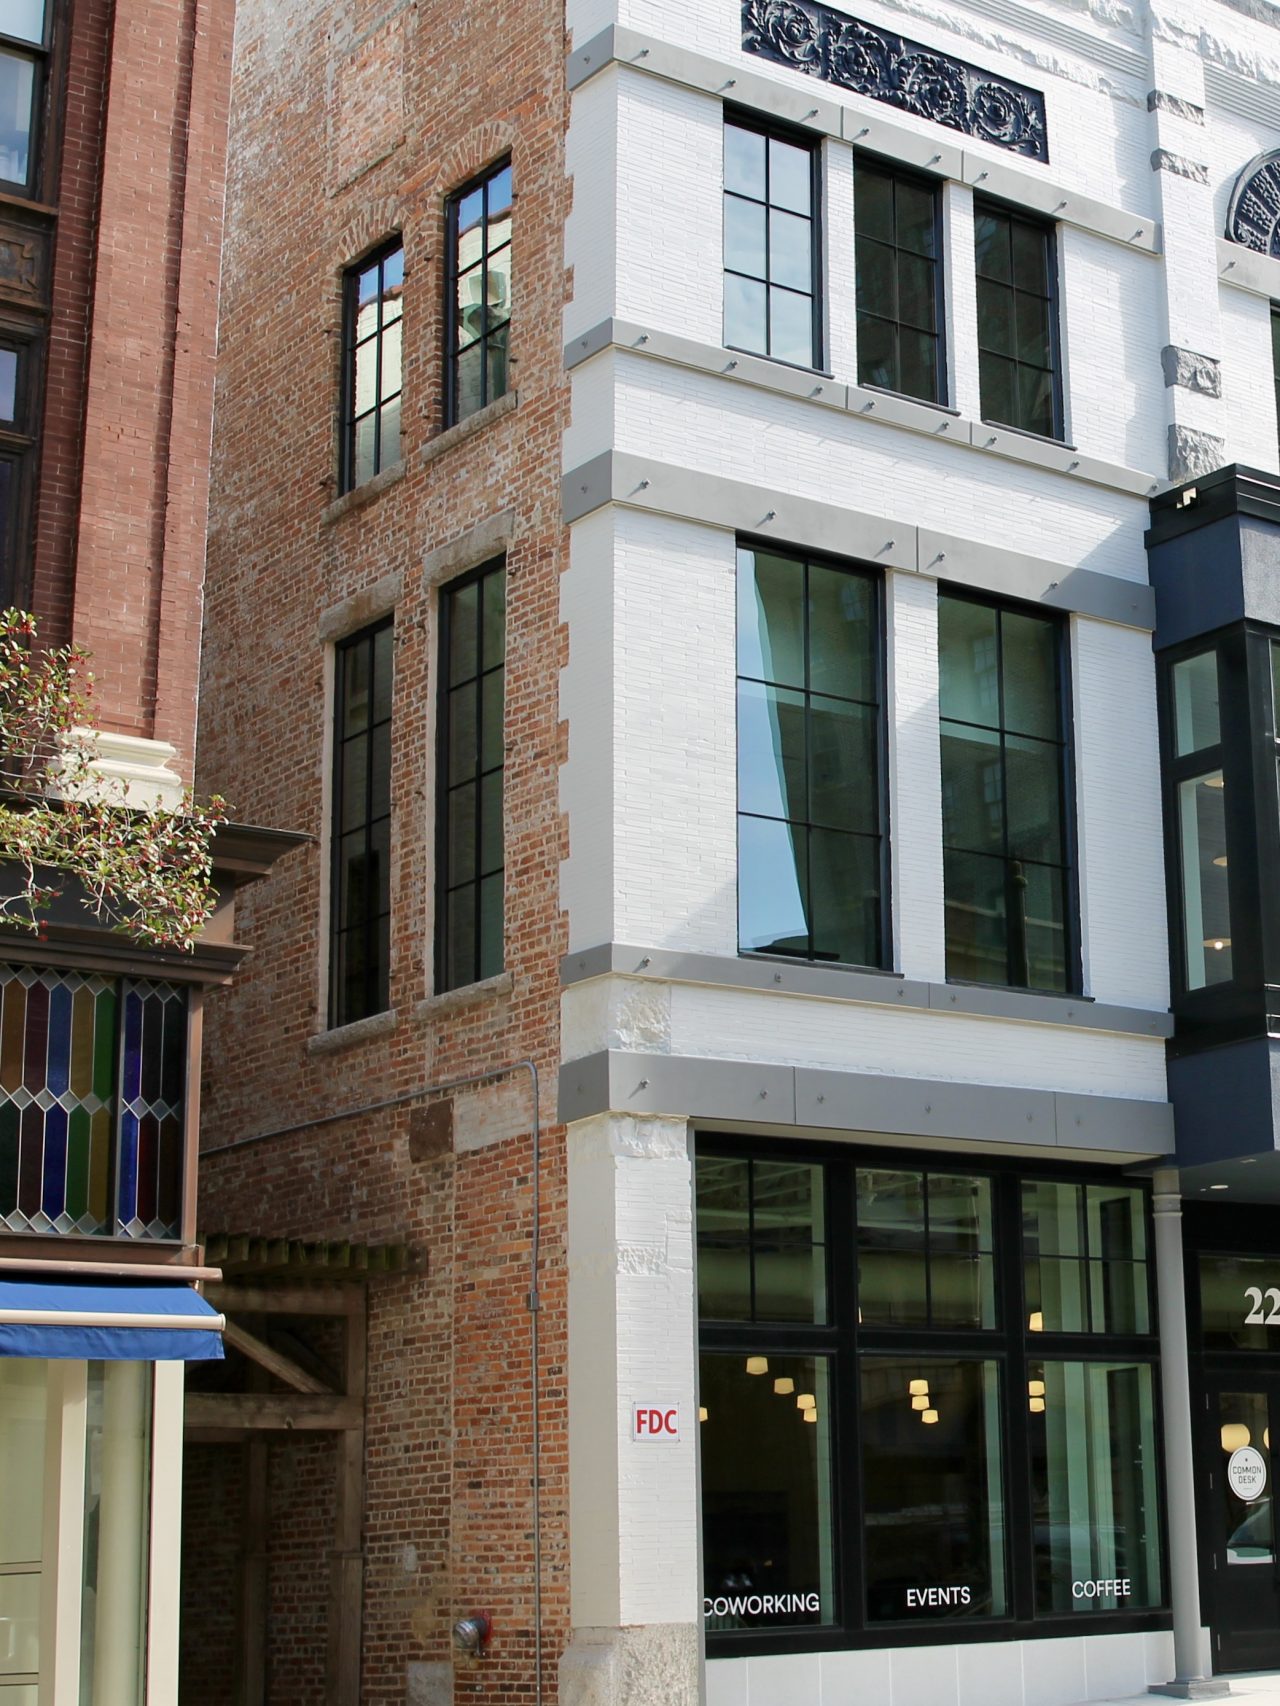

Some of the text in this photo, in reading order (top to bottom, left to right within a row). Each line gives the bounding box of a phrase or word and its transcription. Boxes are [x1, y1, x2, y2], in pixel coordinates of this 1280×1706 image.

[636, 1409, 677, 1434] FDC
[1232, 1466, 1262, 1475] COMMON
[1238, 1476, 1257, 1484] DESK
[906, 1586, 971, 1607] EVENTS
[1072, 1578, 1131, 1598] COFFEE
[703, 1592, 820, 1617] COWORKING
